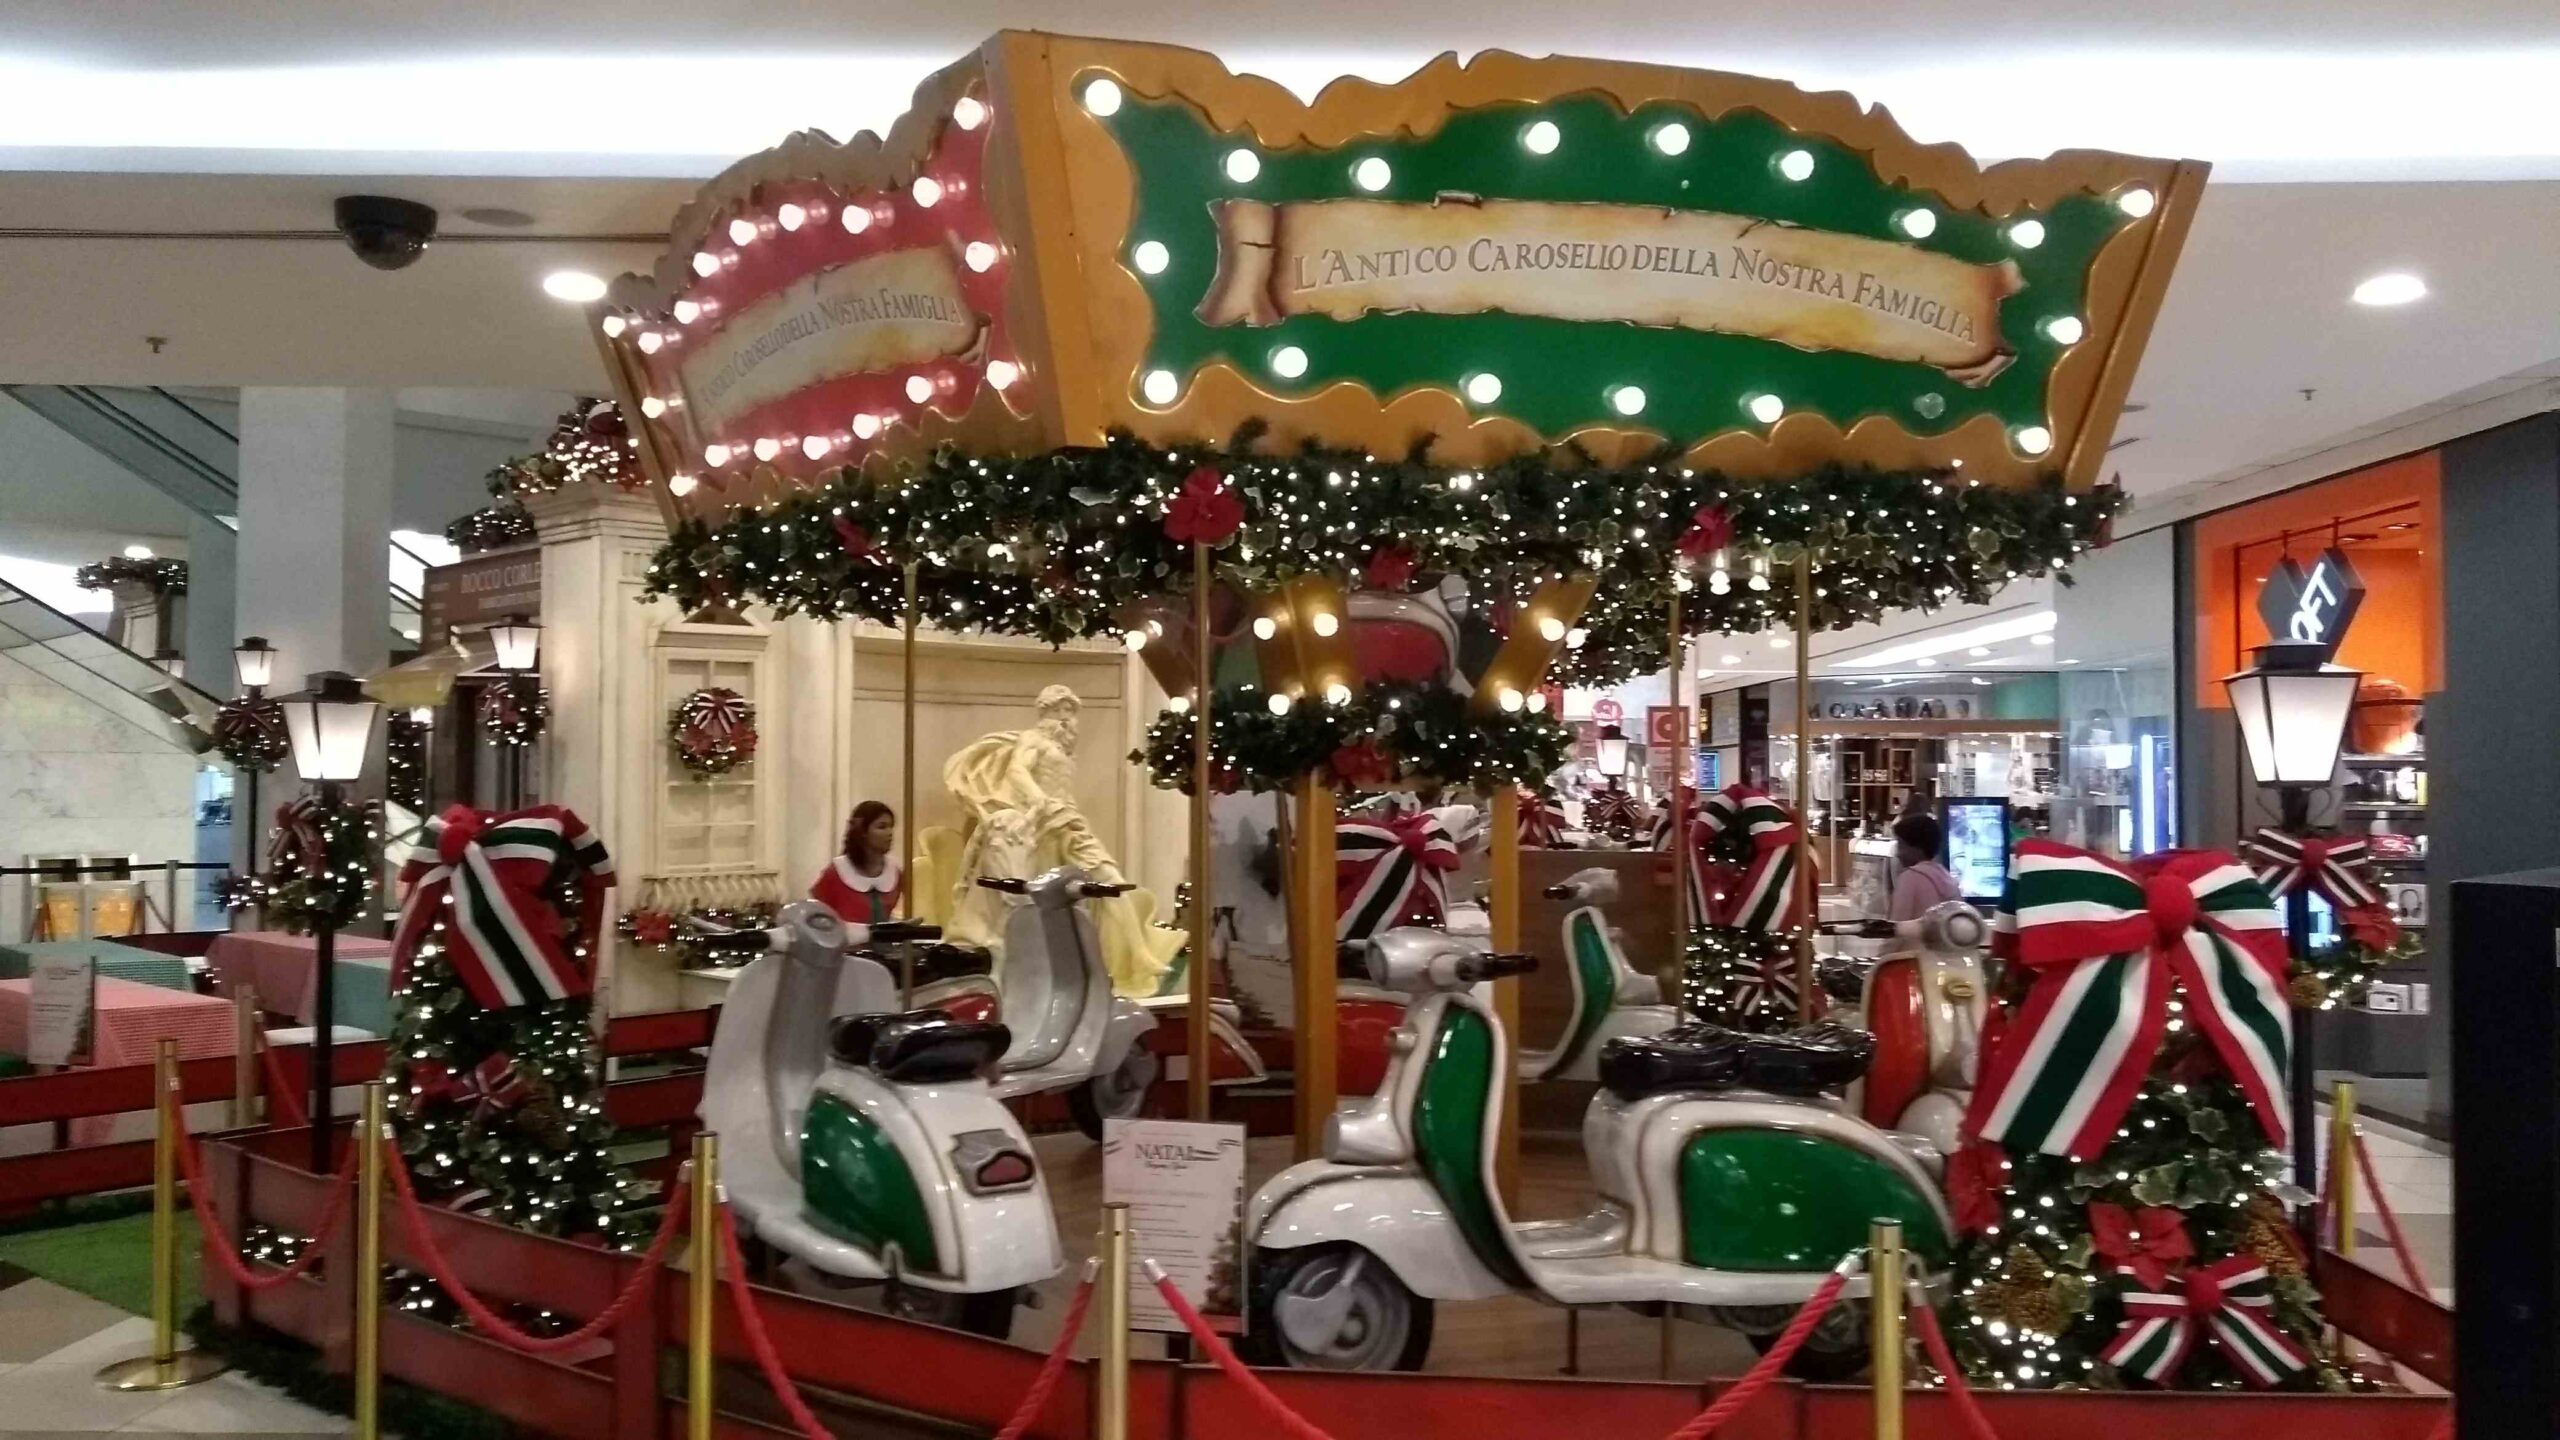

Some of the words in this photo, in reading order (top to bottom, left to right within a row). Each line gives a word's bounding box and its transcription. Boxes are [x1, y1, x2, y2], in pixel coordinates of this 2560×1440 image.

[815, 299, 880, 331] NOSTRA
[880, 287, 964, 326] FAMIGLIA
[1293, 246, 1457, 294] L'ANTICO
[1468, 238, 1627, 273] CAROSELLO
[1631, 244, 1720, 278] DELLA
[1731, 246, 1845, 300] NOSTRA
[1852, 271, 1977, 344] FAMIGLIA
